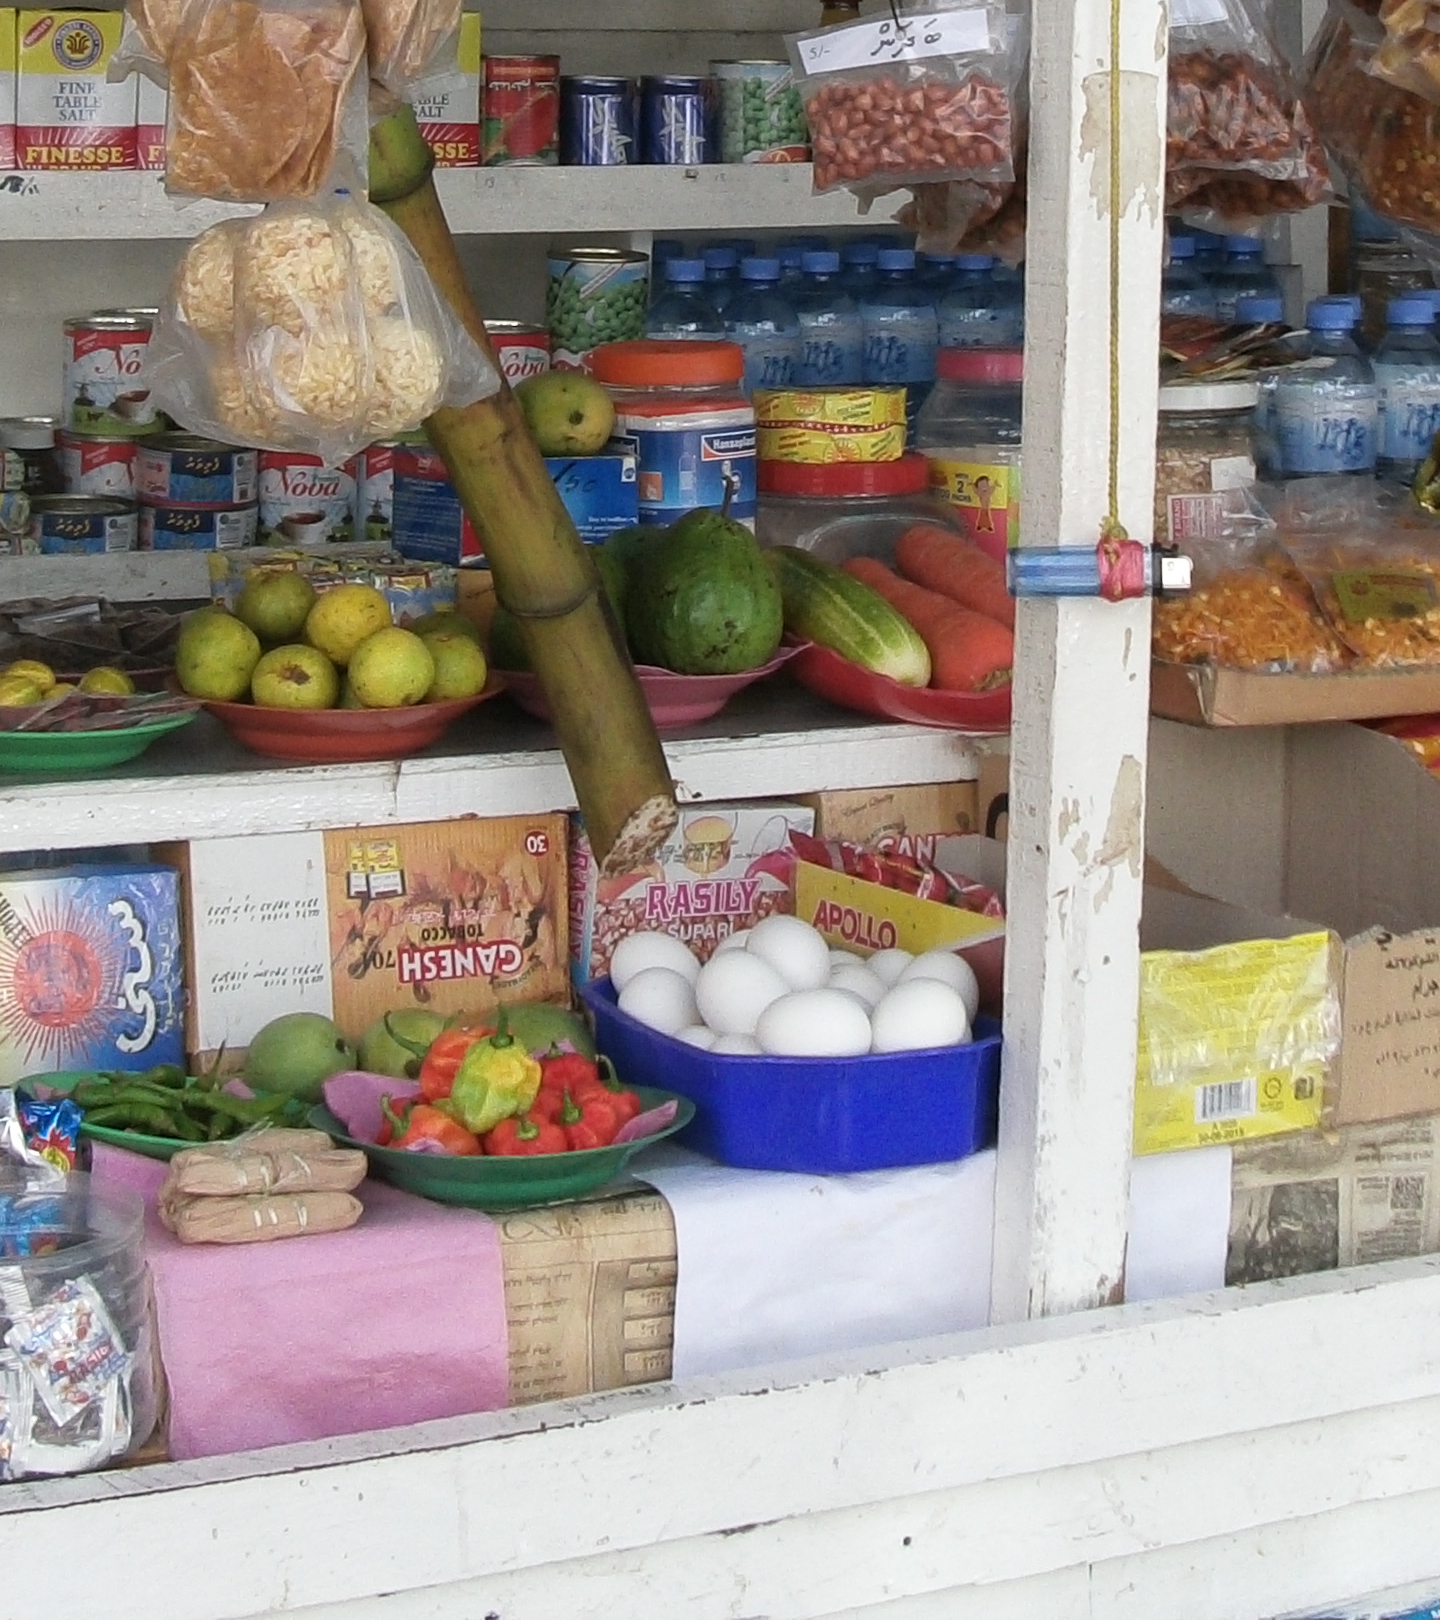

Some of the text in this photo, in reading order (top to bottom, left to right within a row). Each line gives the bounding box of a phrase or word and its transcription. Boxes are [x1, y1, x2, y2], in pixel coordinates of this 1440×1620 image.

[52, 96, 103, 108] TABLE
[415, 94, 449, 105] ABLE
[59, 109, 98, 121] SALT
[416, 106, 445, 118] ALT
[25, 146, 124, 164] FINESSE
[264, 470, 340, 498] Nova
[526, 834, 548, 853] 30
[645, 879, 759, 921] RASILY
[421, 922, 484, 942] TOBACCO
[668, 920, 735, 940] SUPARI
[813, 899, 898, 949] APOLLO
[399, 943, 525, 983] GANESH
